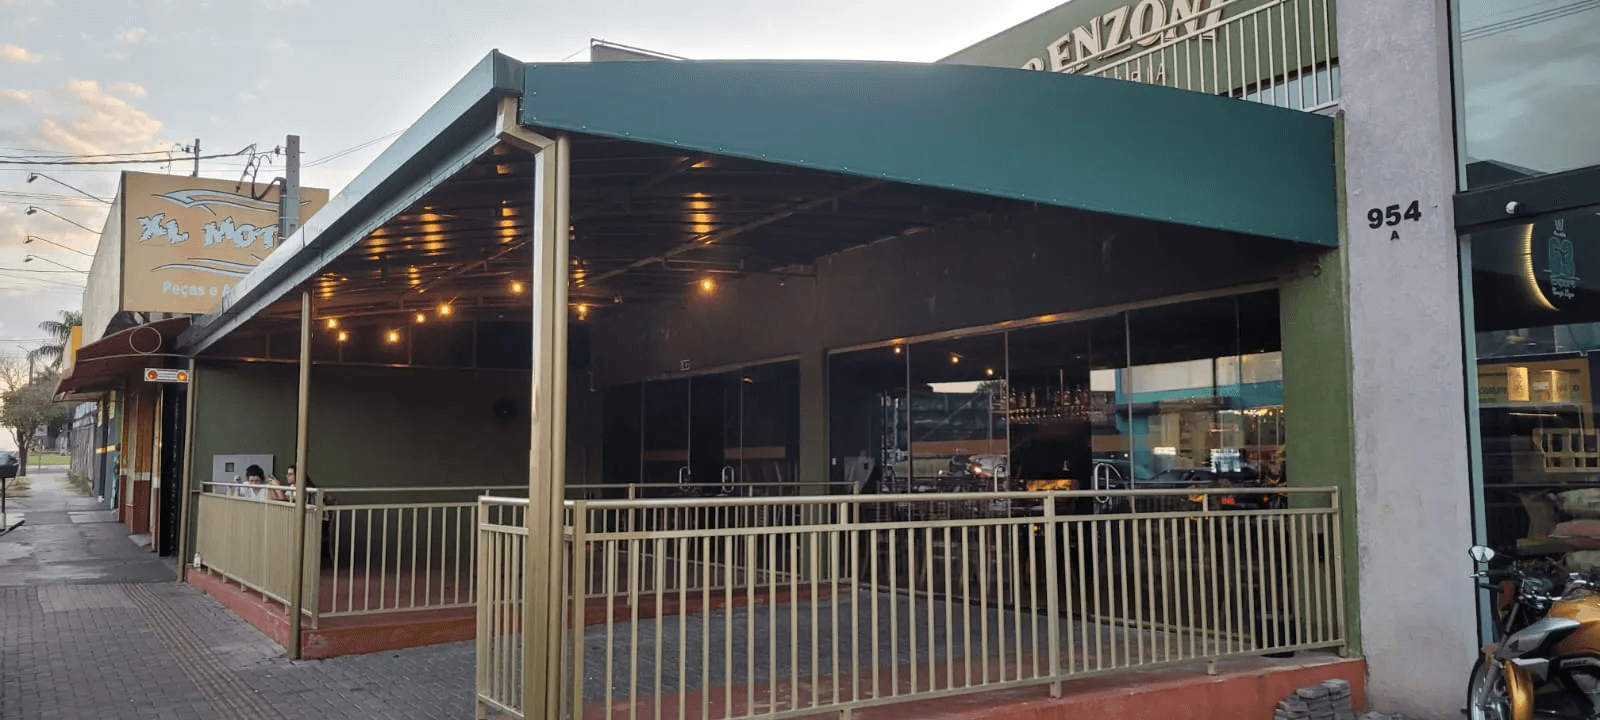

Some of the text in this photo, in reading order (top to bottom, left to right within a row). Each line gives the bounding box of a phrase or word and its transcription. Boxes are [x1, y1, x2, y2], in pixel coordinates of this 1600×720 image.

[1367, 199, 1422, 230] 954
[136, 213, 279, 249] XL MOT
[1390, 230, 1400, 241] A
[162, 281, 205, 297] Peças
[209, 285, 218, 296] e
